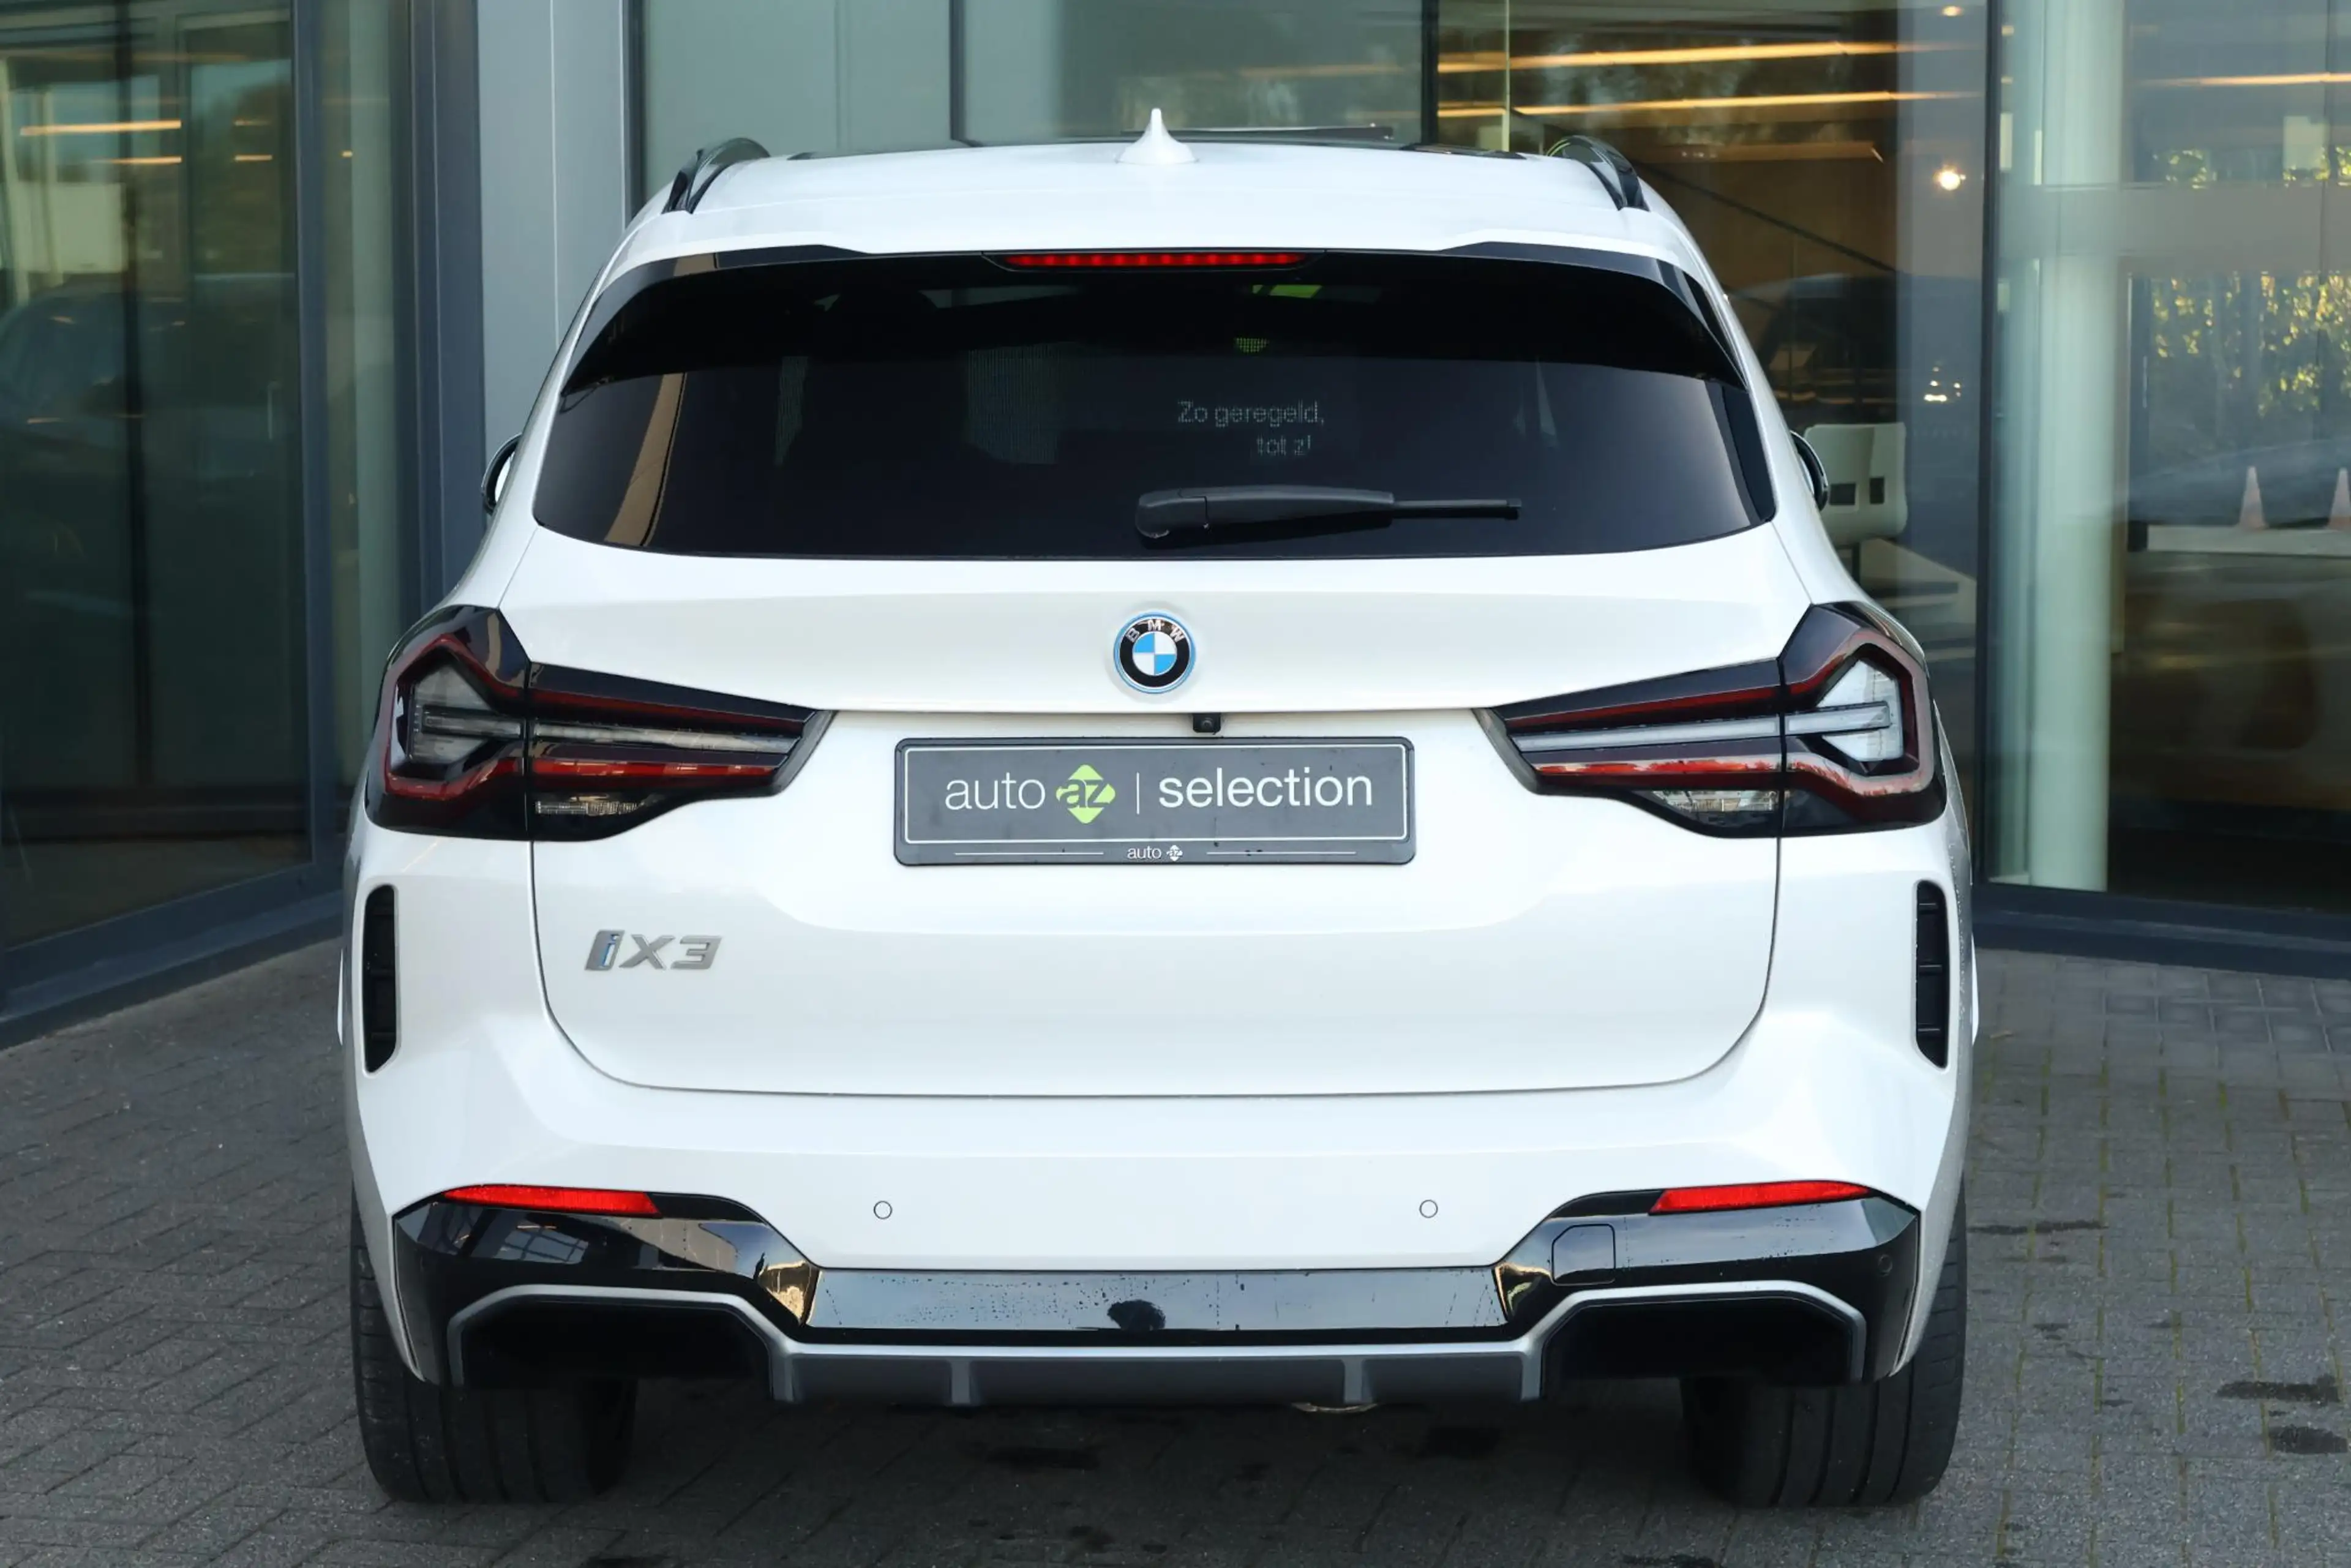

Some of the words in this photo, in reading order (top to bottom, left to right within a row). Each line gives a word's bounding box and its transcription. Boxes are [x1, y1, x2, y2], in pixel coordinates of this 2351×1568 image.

[1177, 399, 1209, 423] Zo
[1214, 399, 1324, 428] geregeld,
[1256, 433, 1287, 456] tot
[1125, 618, 1185, 643] BMW
[945, 772, 1046, 810] auto
[1159, 767, 1372, 808] selection
[1127, 846, 1162, 859] auto
